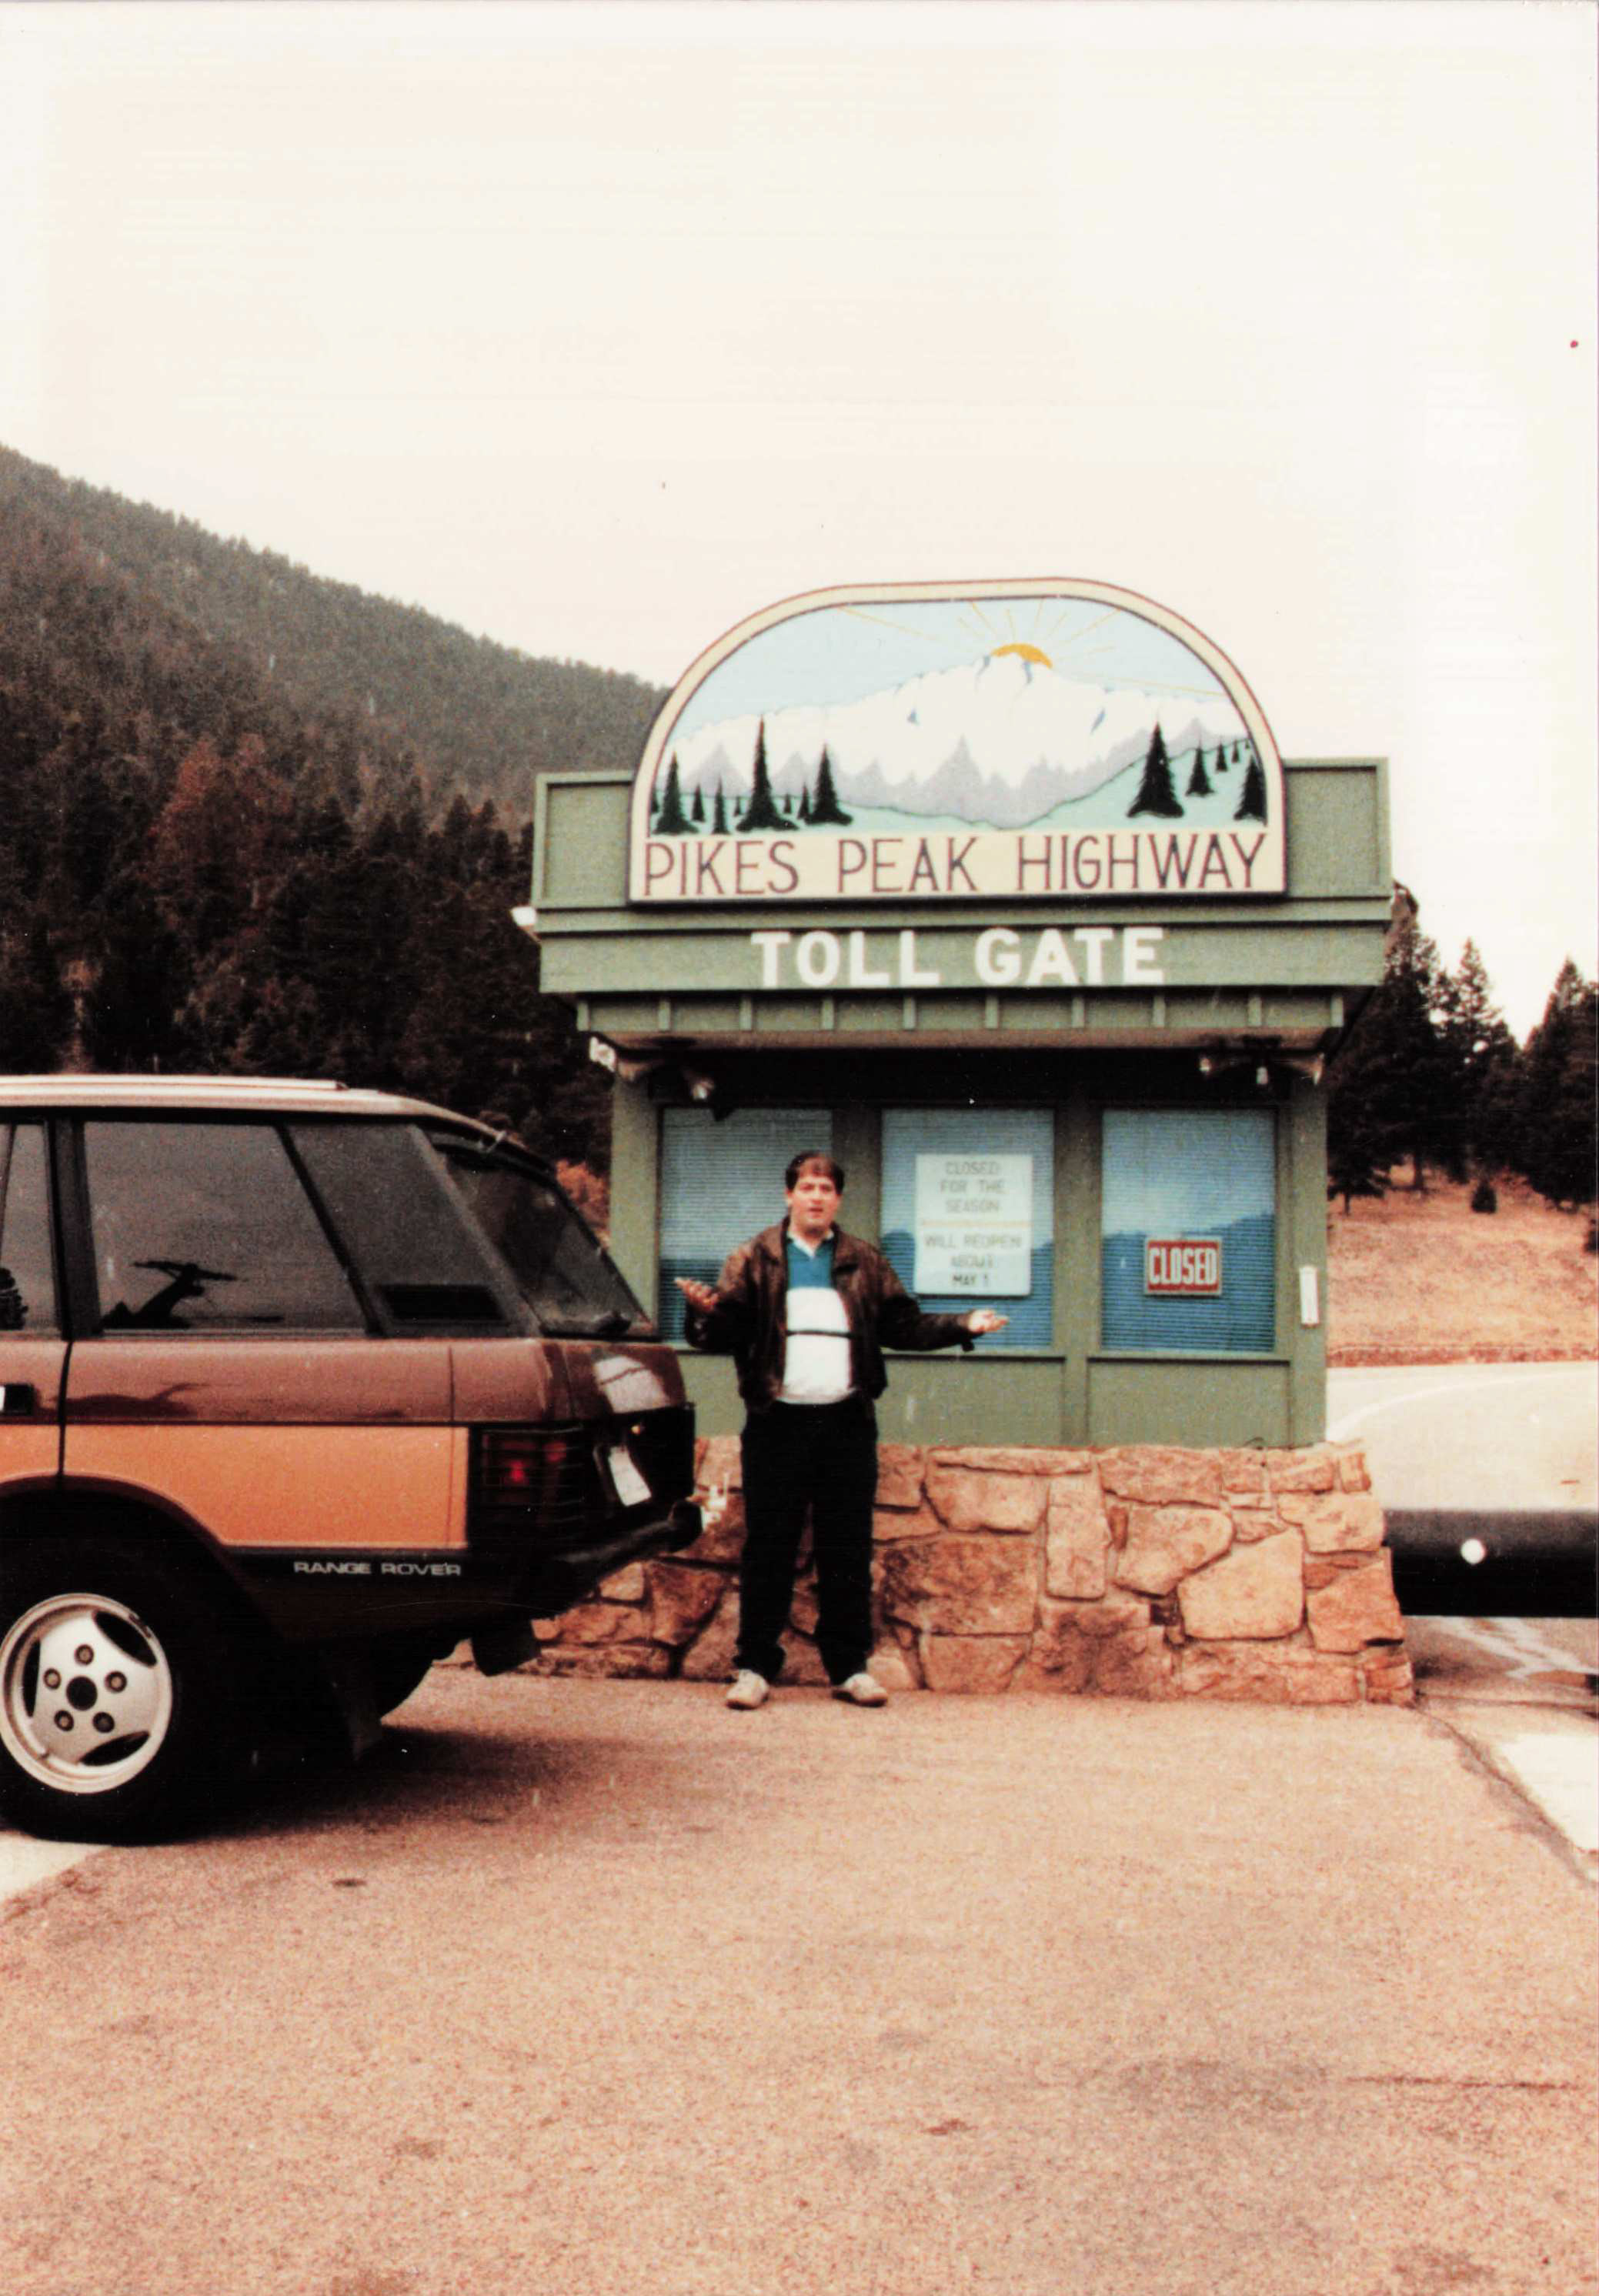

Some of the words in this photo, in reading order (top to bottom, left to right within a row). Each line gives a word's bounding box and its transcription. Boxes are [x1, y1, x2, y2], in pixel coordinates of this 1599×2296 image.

[643, 839, 800, 897] PIKES
[838, 836, 978, 895] PEAK
[1016, 833, 1267, 893] HIGHWAY
[751, 930, 940, 989] TOLL
[973, 926, 1165, 987] GATE
[945, 1160, 1002, 1175] CLOSED
[940, 1179, 968, 1193] FOR
[979, 1179, 1006, 1194] THE
[945, 1199, 1000, 1213] SEASON
[925, 1234, 956, 1249] WILL
[963, 1234, 1022, 1248] REOPEN
[1148, 1247, 1218, 1286] CLOSED
[952, 1273, 977, 1286] MAY
[293, 1561, 372, 1574] RANGE
[381, 1563, 461, 1576] ROVER
